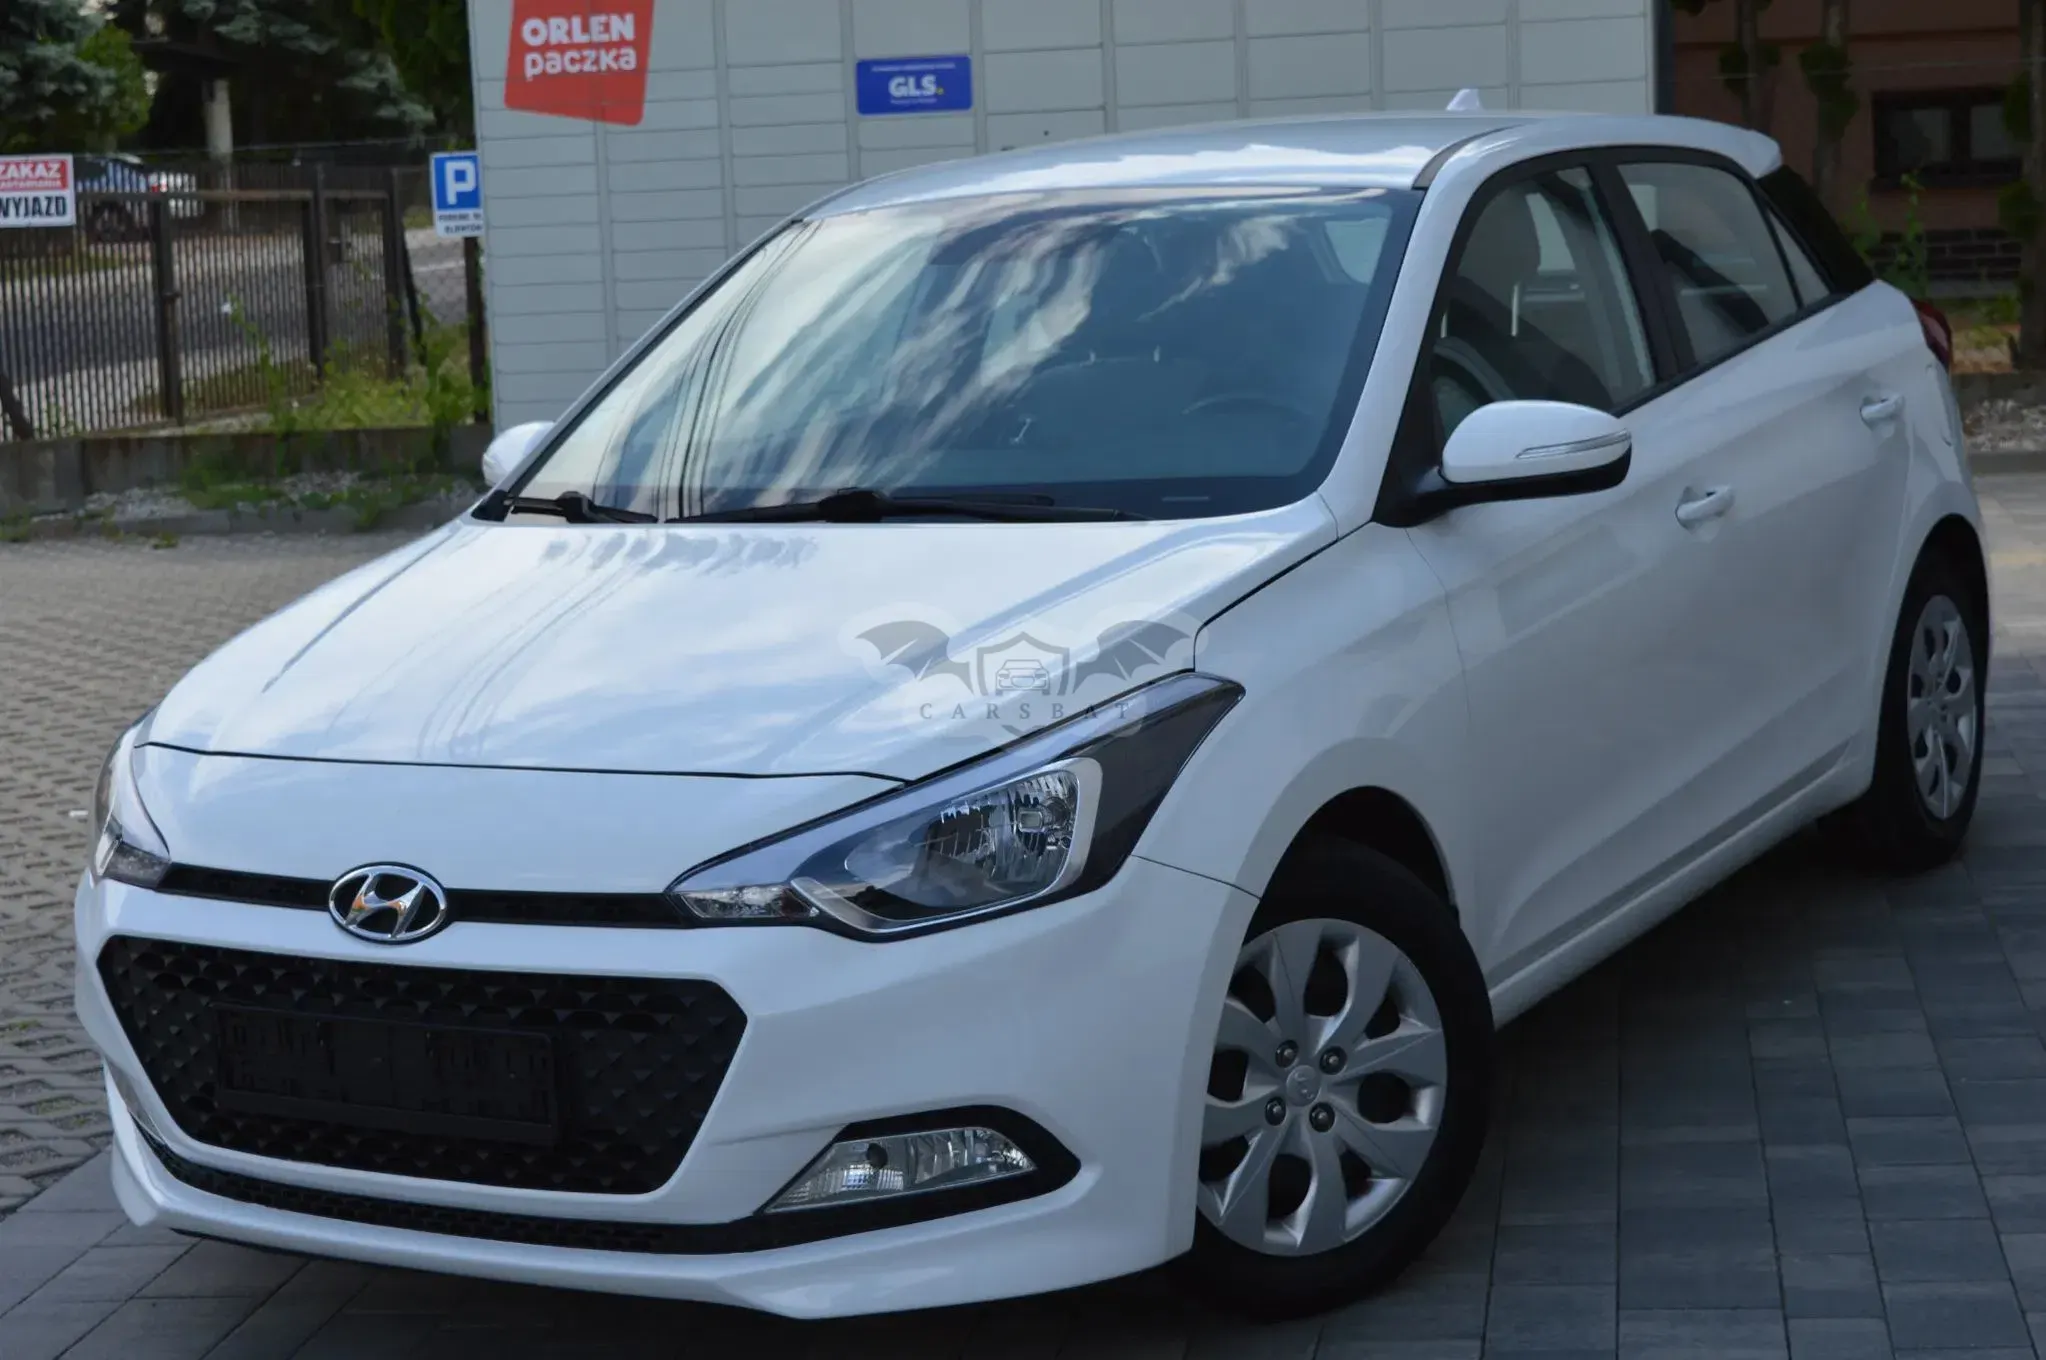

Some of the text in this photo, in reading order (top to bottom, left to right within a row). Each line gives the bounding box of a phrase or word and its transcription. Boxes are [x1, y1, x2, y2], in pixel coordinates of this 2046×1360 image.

[522, 12, 635, 47] ORLEN
[524, 45, 637, 82] paczka
[445, 160, 477, 205] P
